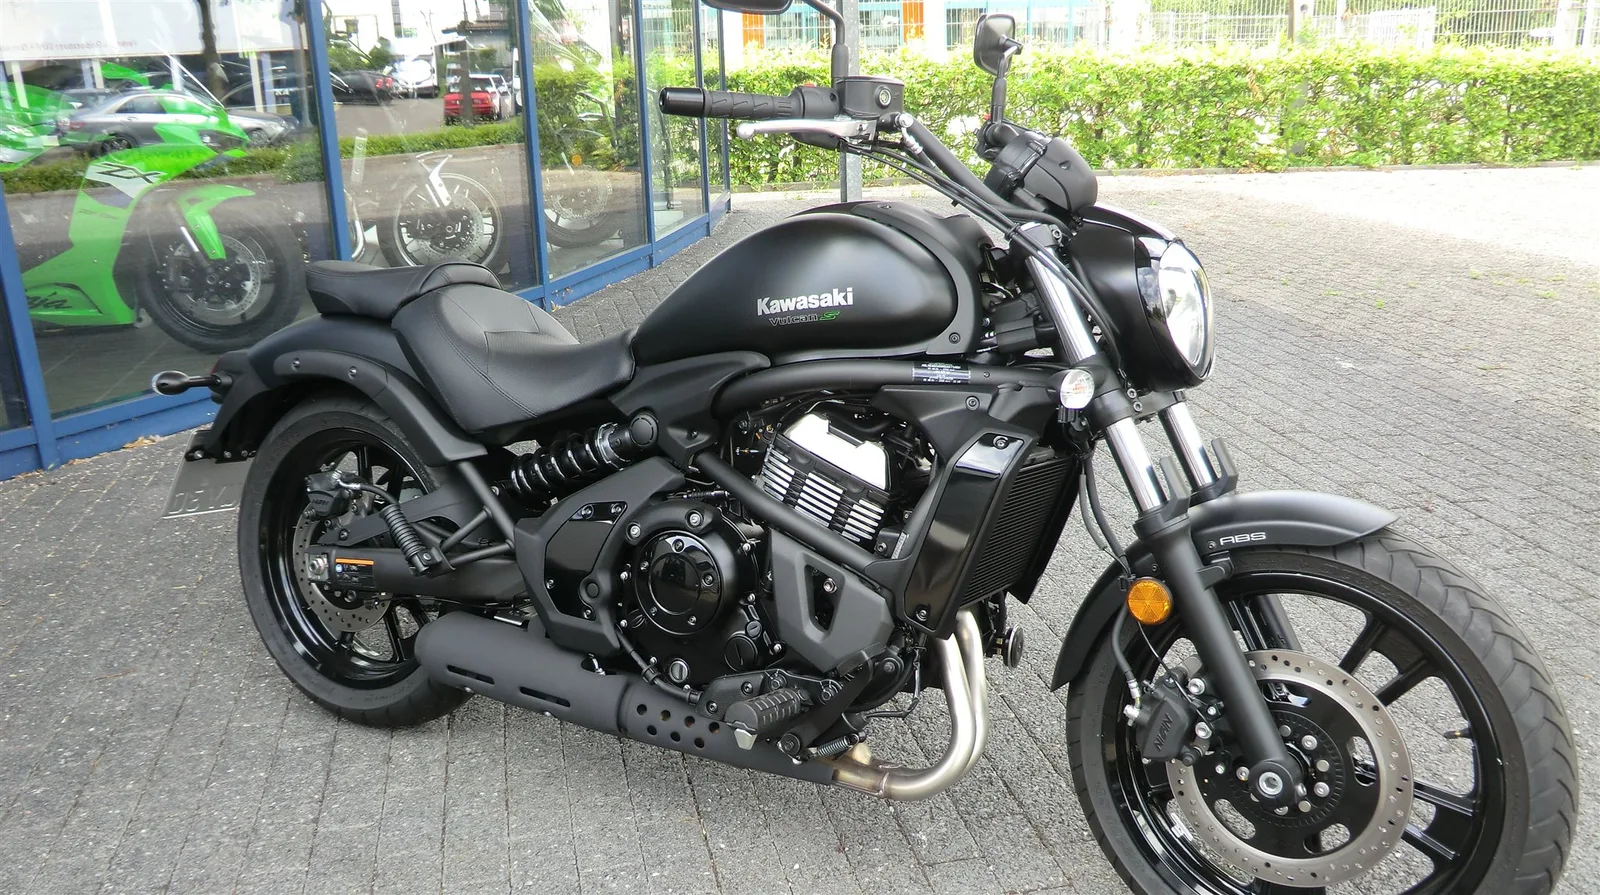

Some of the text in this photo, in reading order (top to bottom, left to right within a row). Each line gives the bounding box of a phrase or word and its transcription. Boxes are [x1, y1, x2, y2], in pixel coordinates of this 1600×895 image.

[757, 287, 854, 316] Kawasaki
[819, 311, 841, 321] S
[1219, 531, 1267, 546] ABS
